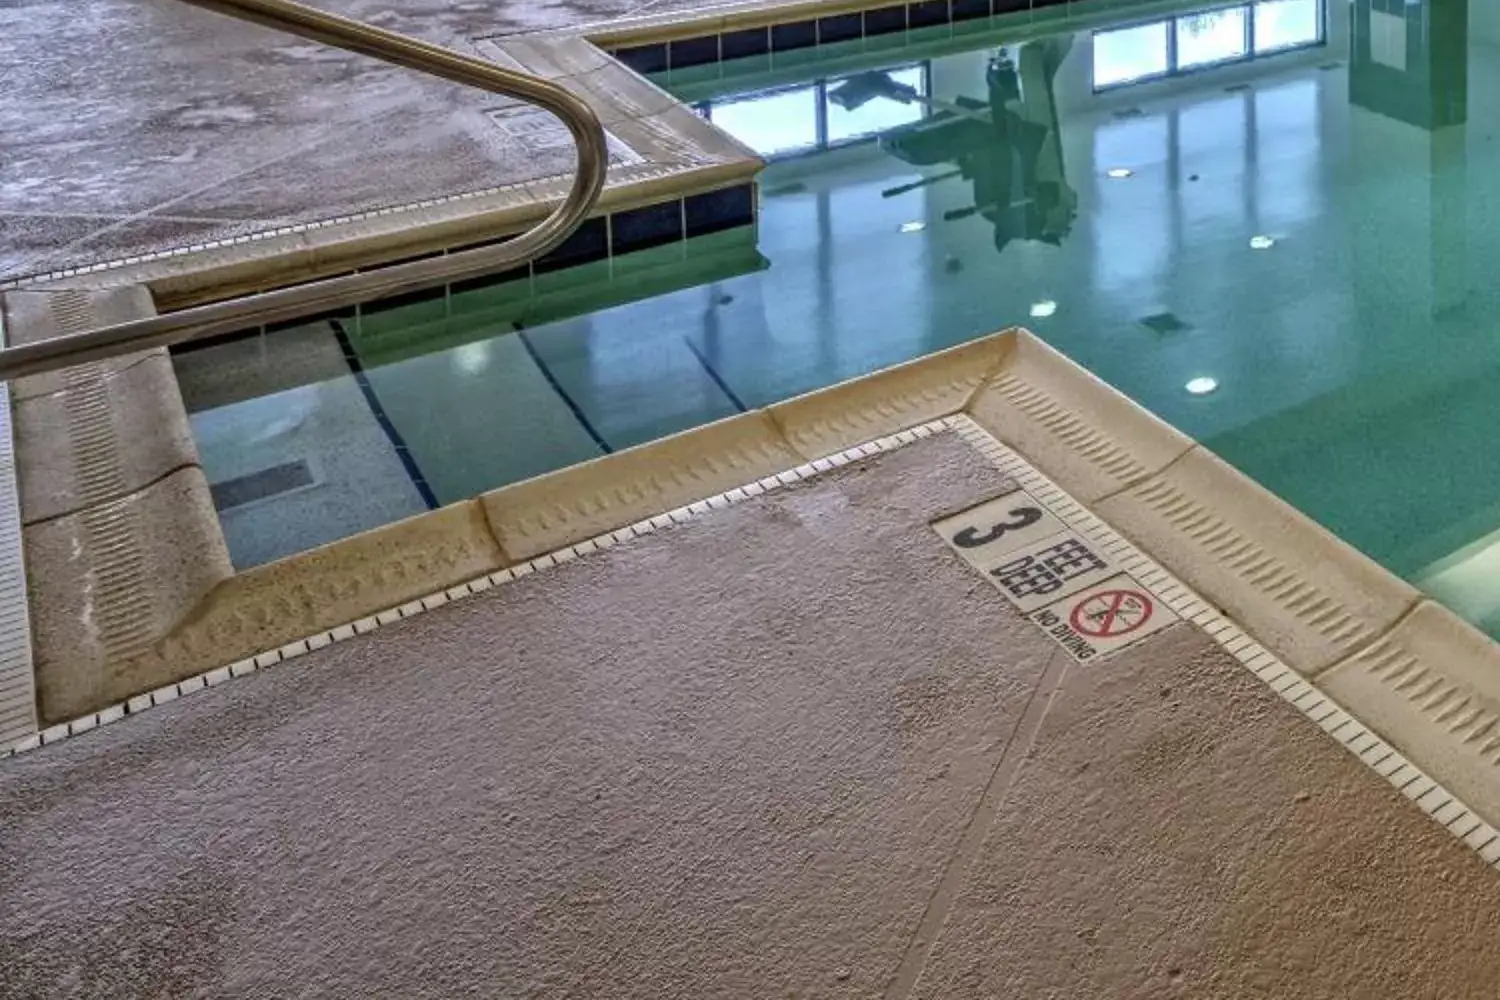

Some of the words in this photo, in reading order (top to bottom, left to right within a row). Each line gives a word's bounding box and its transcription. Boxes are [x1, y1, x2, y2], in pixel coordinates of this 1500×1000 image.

[953, 507, 1042, 548] 3
[990, 555, 1064, 598] DEEP
[1034, 538, 1107, 581] FEET
[1035, 609, 1059, 628] NO
[1050, 622, 1098, 661] DIVING
